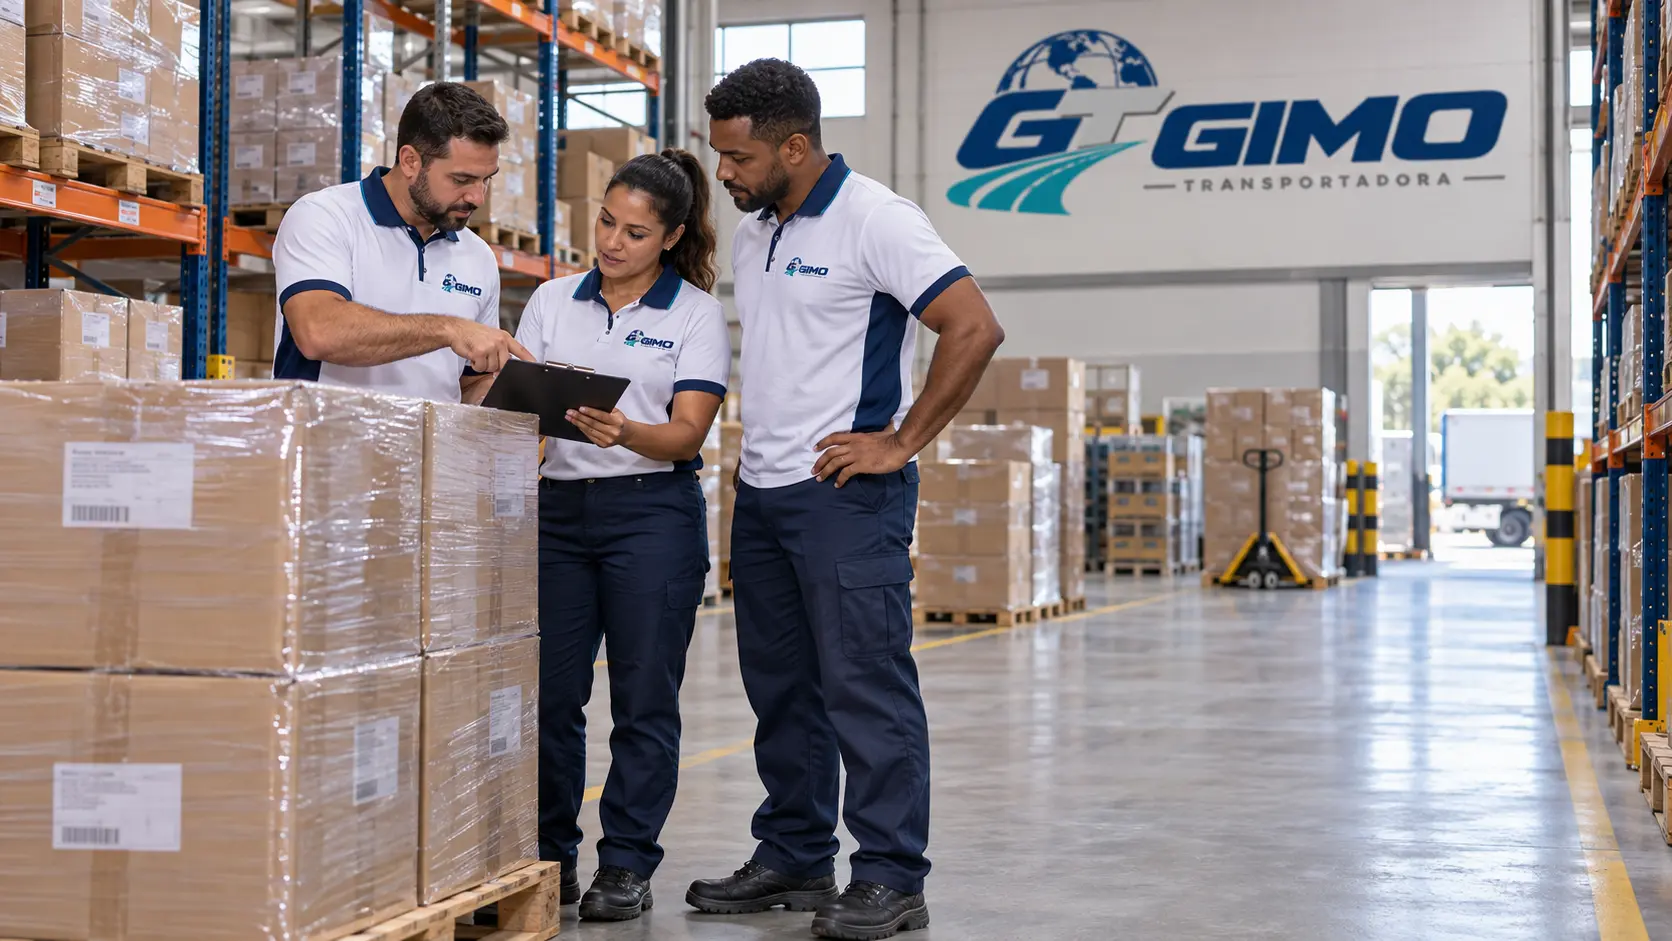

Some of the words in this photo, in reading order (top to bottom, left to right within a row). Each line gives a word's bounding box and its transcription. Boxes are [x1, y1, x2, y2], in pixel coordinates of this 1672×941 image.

[956, 86, 1175, 170] GT
[1151, 90, 1508, 169] GIMO
[1184, 172, 1452, 192] TRANSPORTADORA
[799, 265, 829, 275] GIMO
[455, 283, 482, 296] GIMO
[641, 337, 674, 349] GIMO
